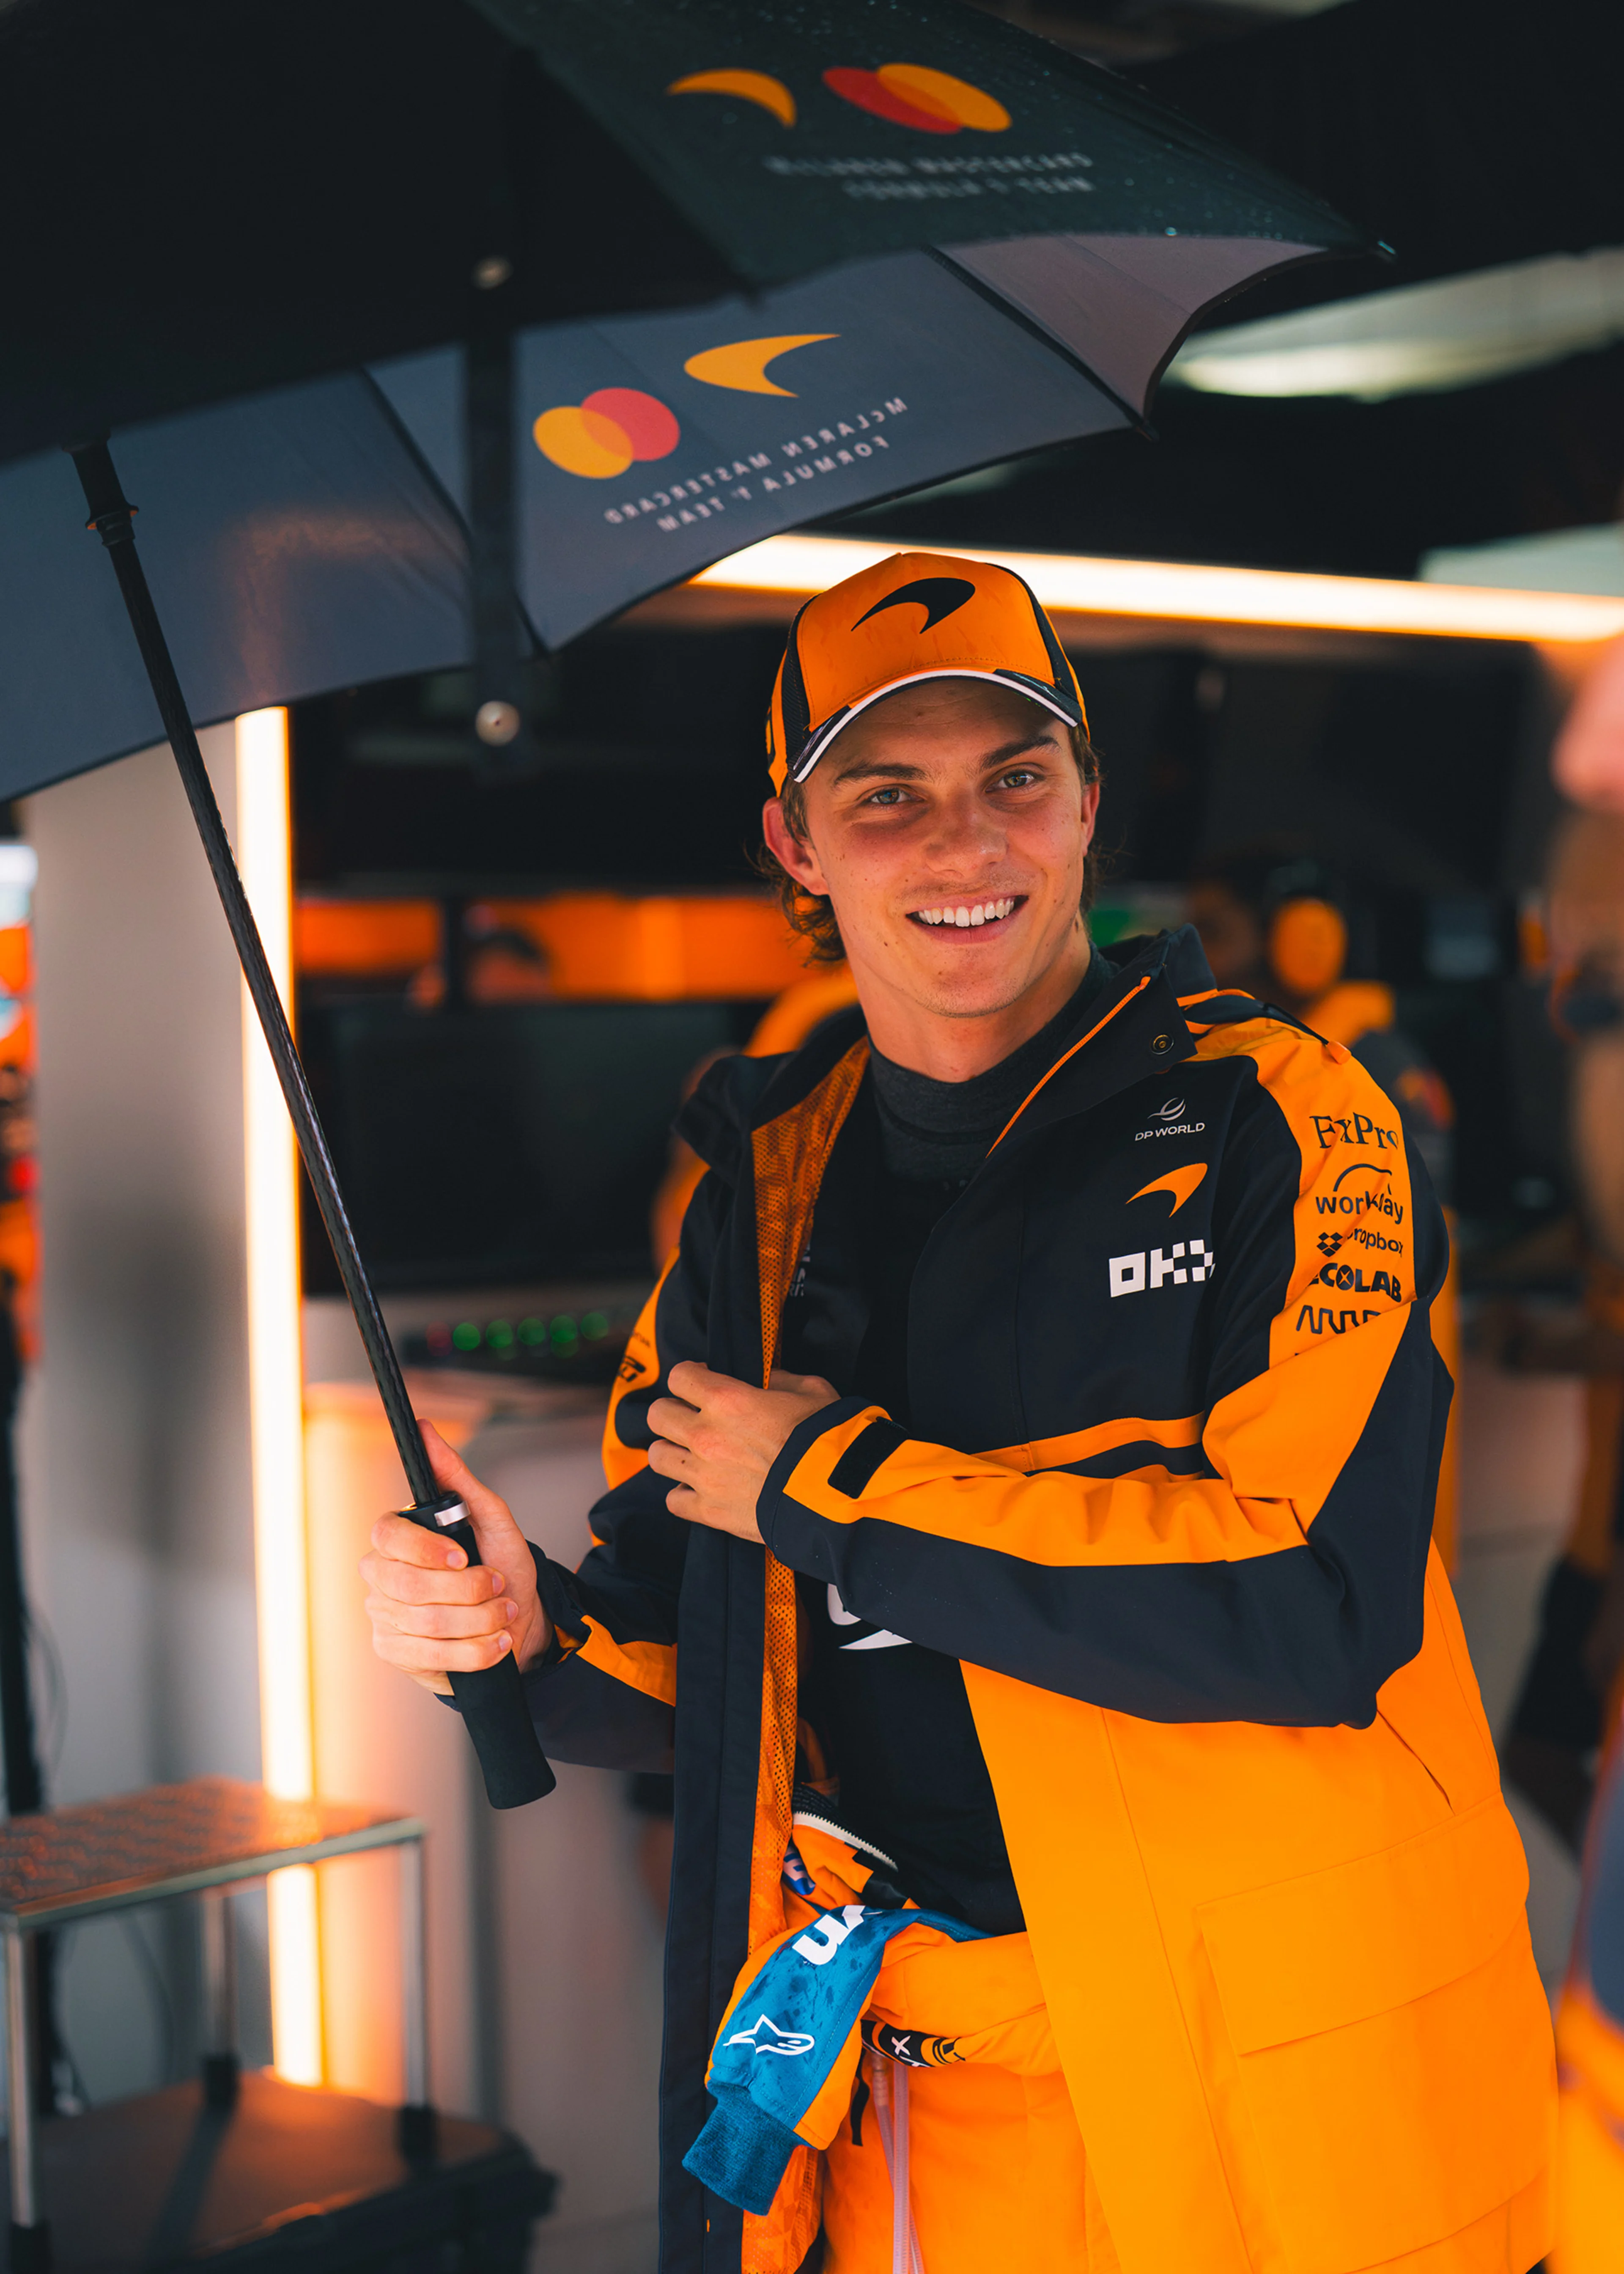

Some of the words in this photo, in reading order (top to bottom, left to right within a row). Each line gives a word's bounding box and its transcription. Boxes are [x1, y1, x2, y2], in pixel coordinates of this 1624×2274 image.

[1135, 1130, 1154, 1141] DP
[1155, 1122, 1205, 1138] WORLD
[1309, 1112, 1399, 1150] FxPro
